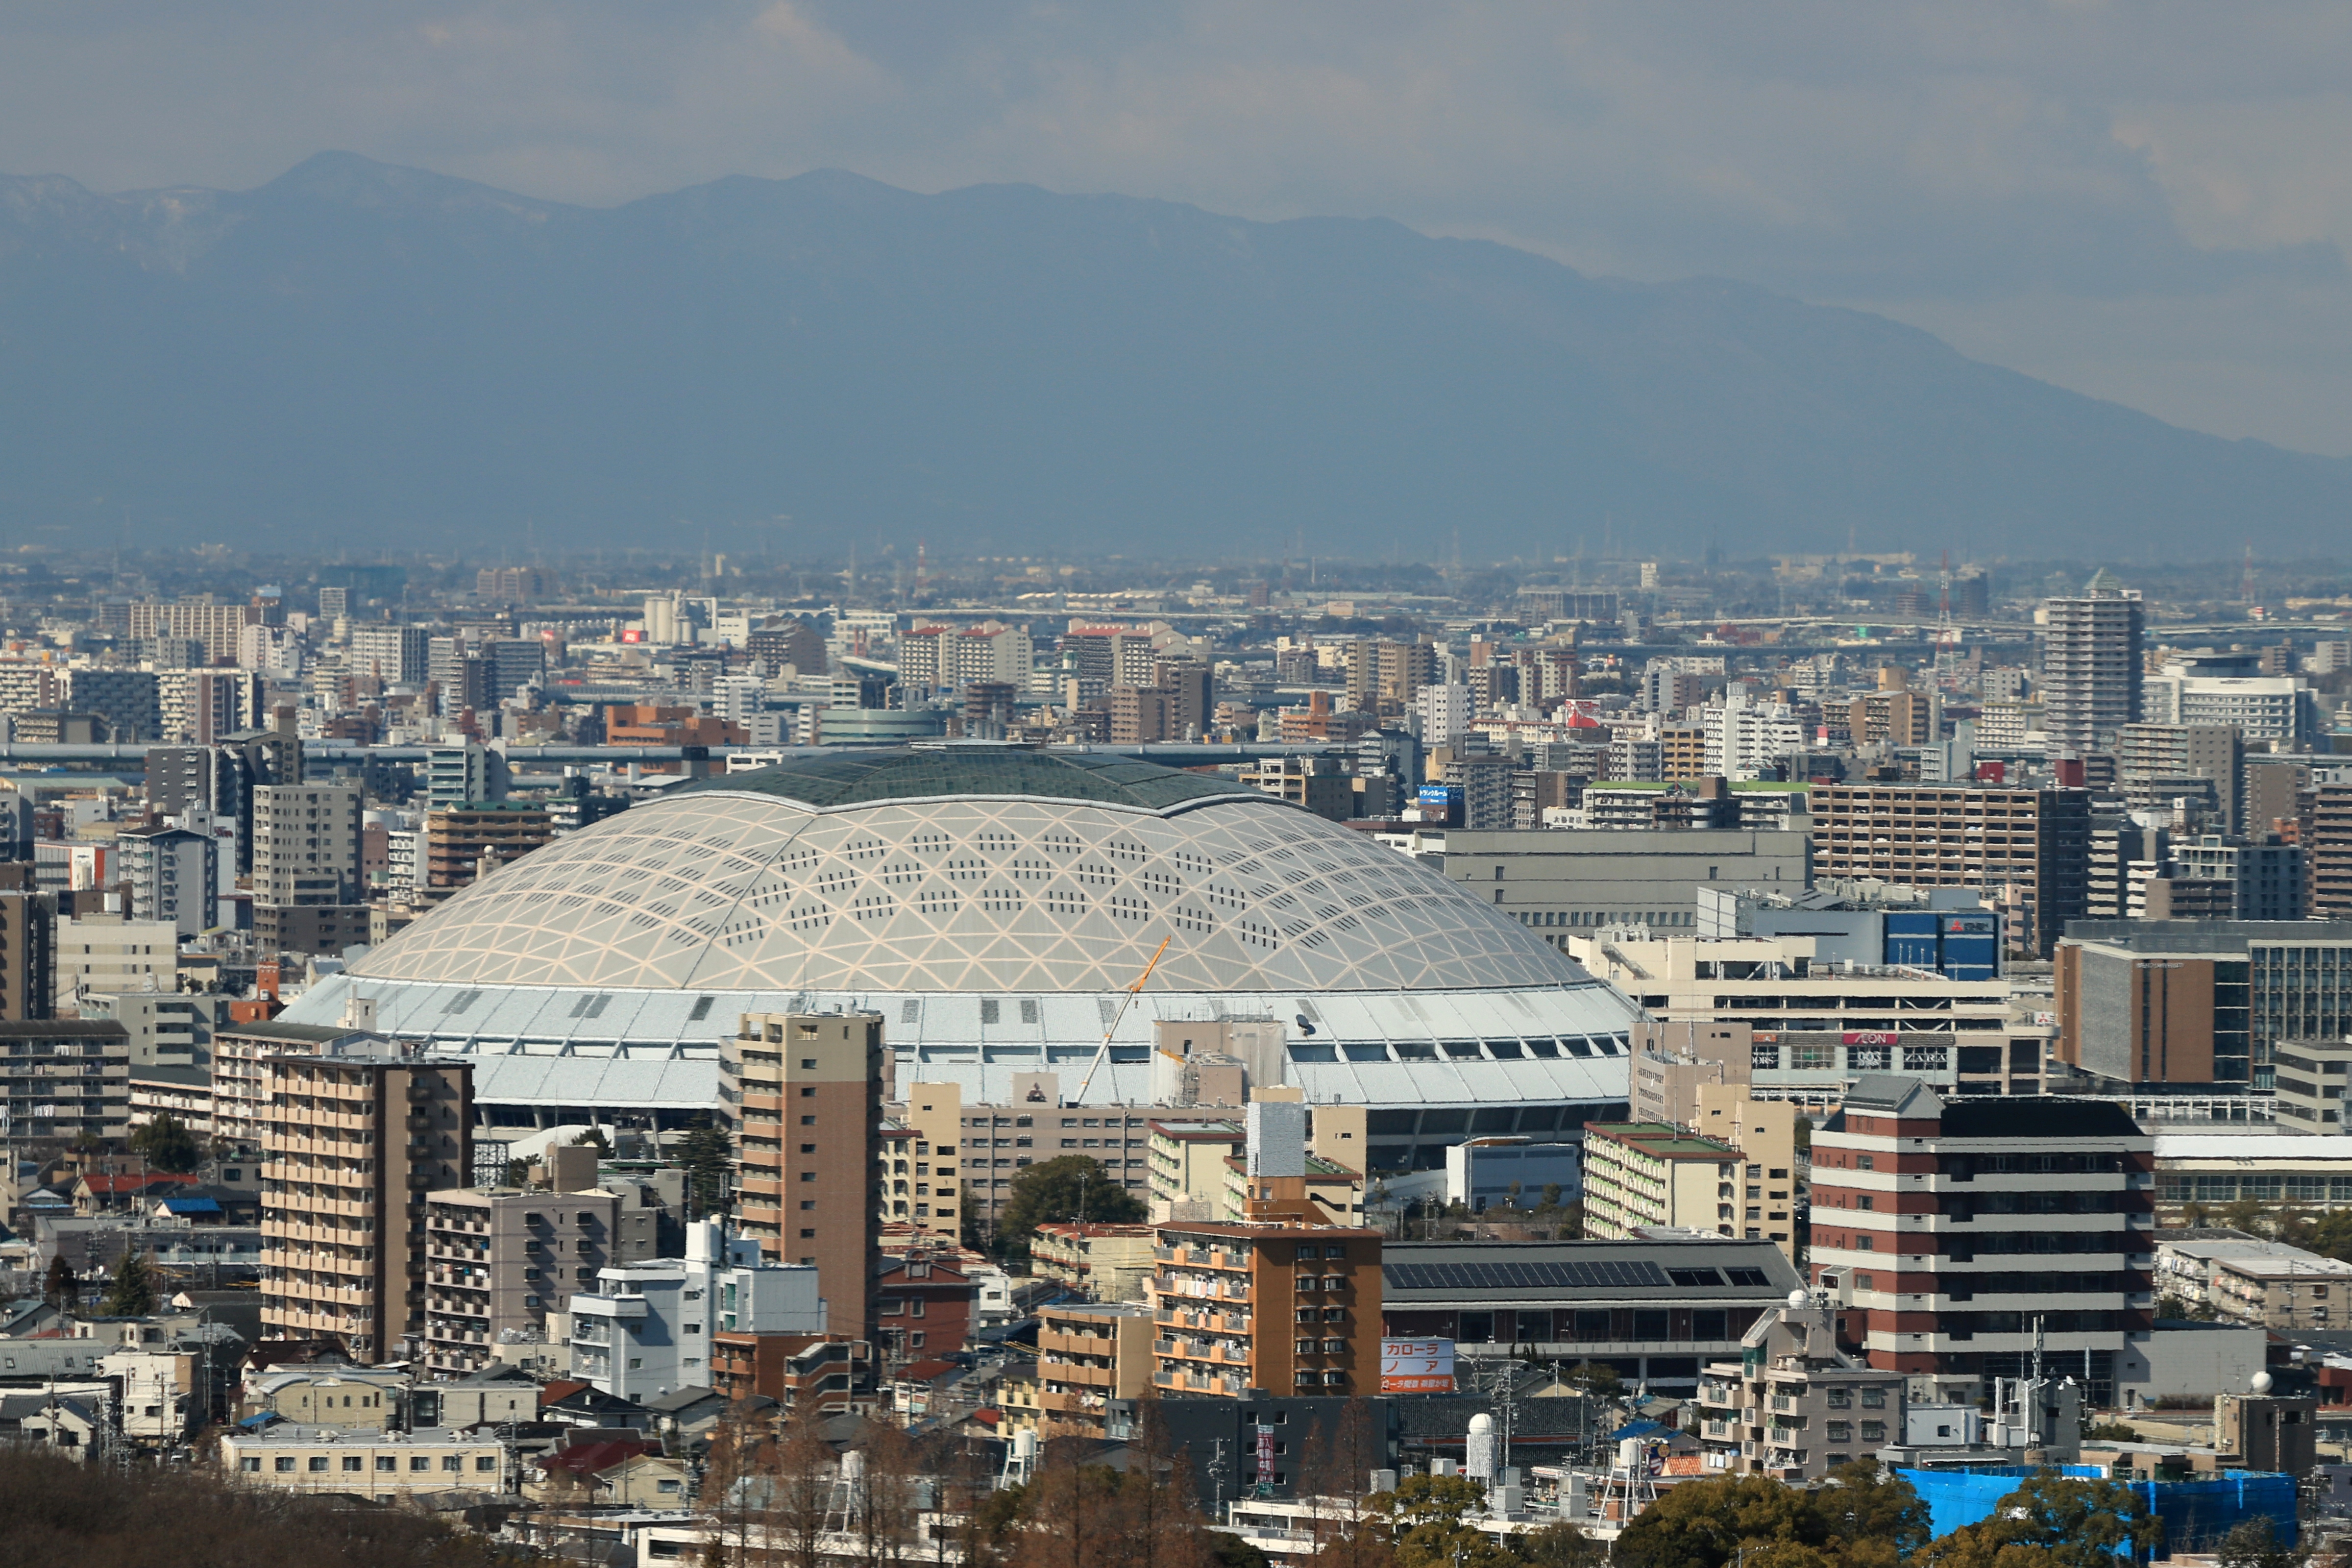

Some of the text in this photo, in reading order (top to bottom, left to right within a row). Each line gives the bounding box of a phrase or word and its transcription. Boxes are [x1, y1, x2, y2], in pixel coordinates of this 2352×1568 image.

[1905, 1054, 1946, 1062] ZARA
[1387, 1344, 1439, 1355] カローラ
